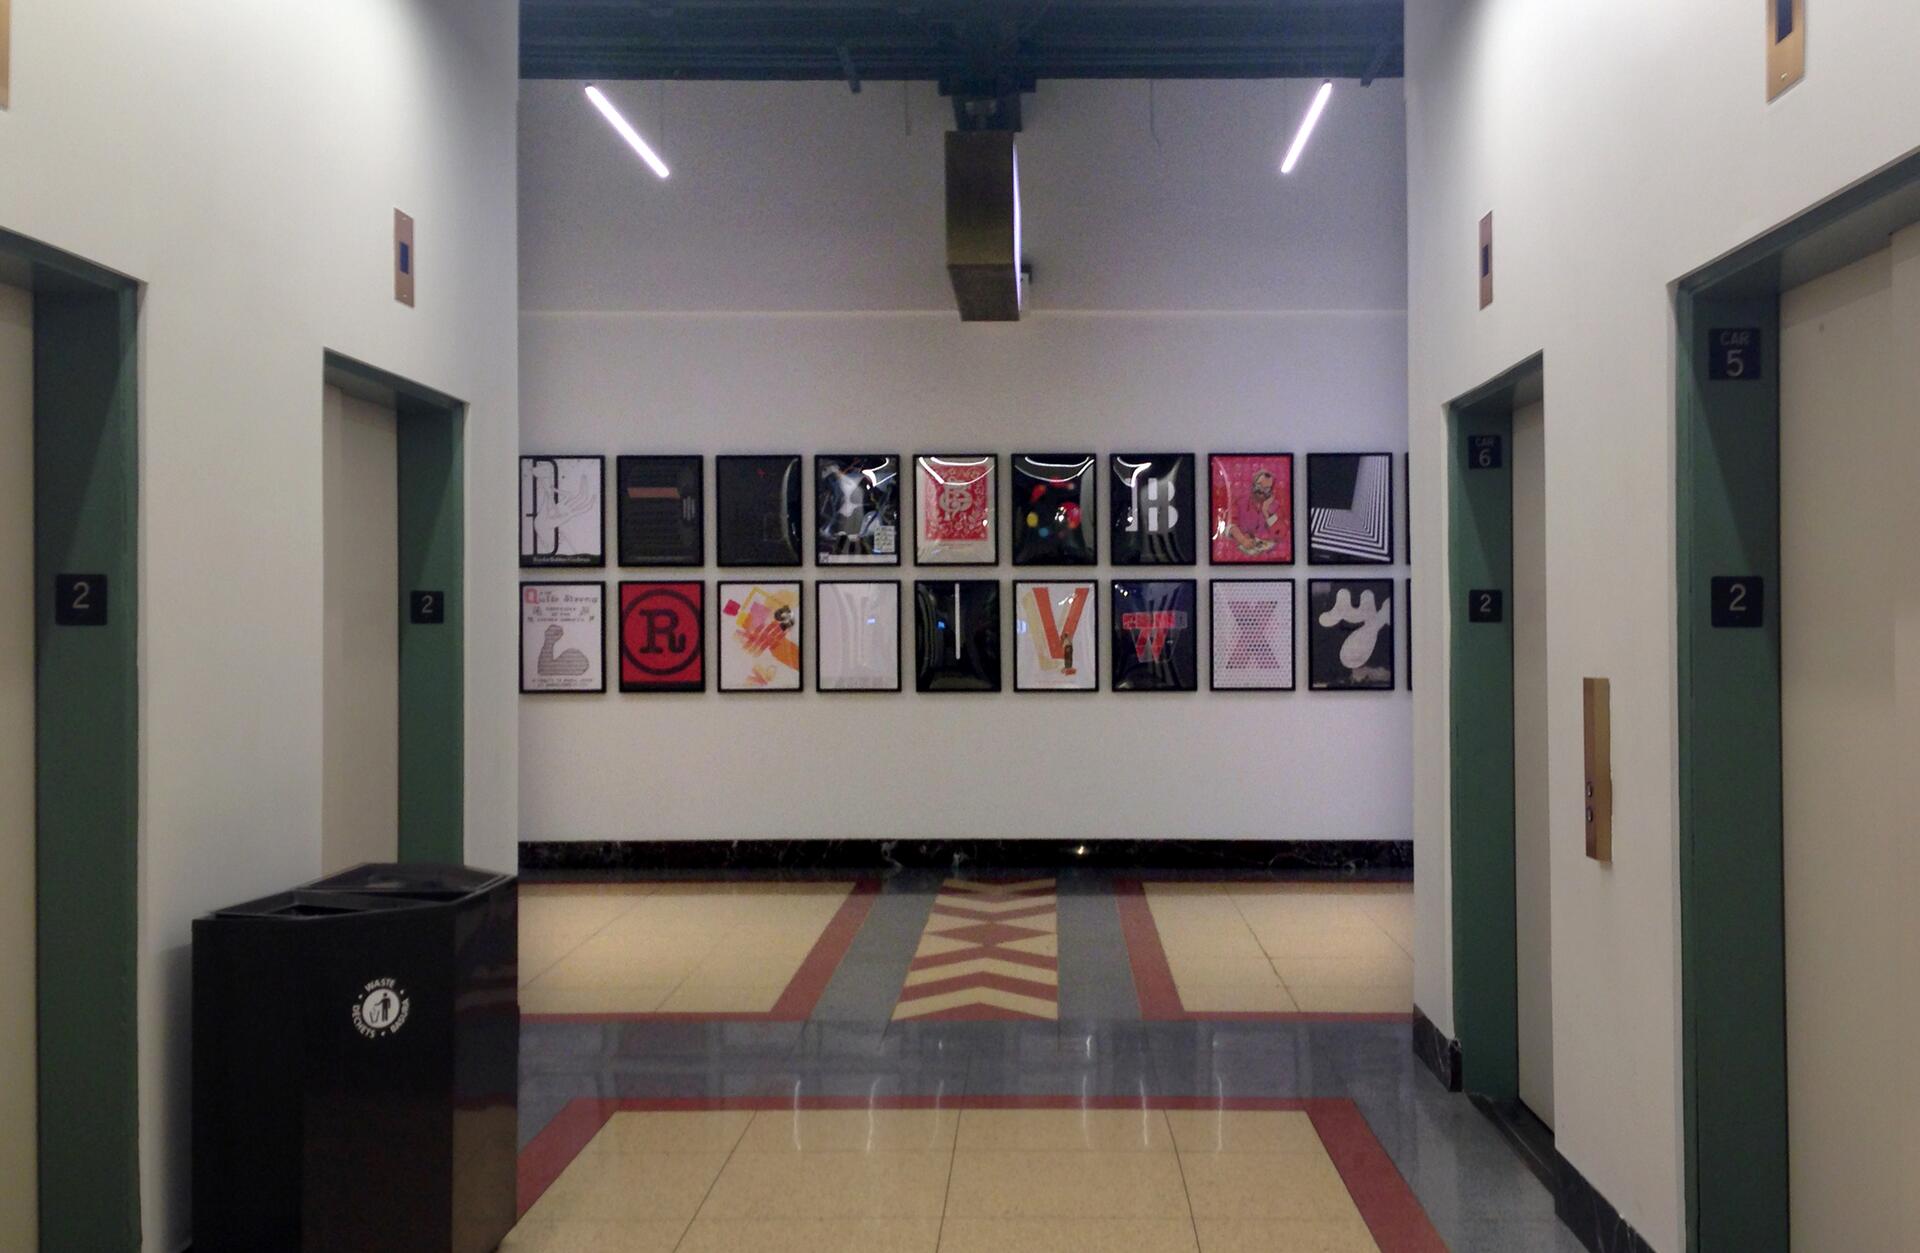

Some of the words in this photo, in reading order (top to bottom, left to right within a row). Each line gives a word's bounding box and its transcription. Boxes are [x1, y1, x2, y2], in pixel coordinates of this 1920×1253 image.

[1720, 331, 1749, 346] CAR
[1727, 349, 1744, 377] 5
[1479, 449, 1491, 467] 6
[72, 582, 90, 608] 2
[422, 595, 433, 613] 2
[1480, 594, 1491, 612] 2
[1729, 583, 1747, 611] 2
[638, 608, 686, 654] R
[1031, 587, 1090, 659] V
[364, 978, 396, 992] WASTE
[390, 998, 410, 1033] BASURA
